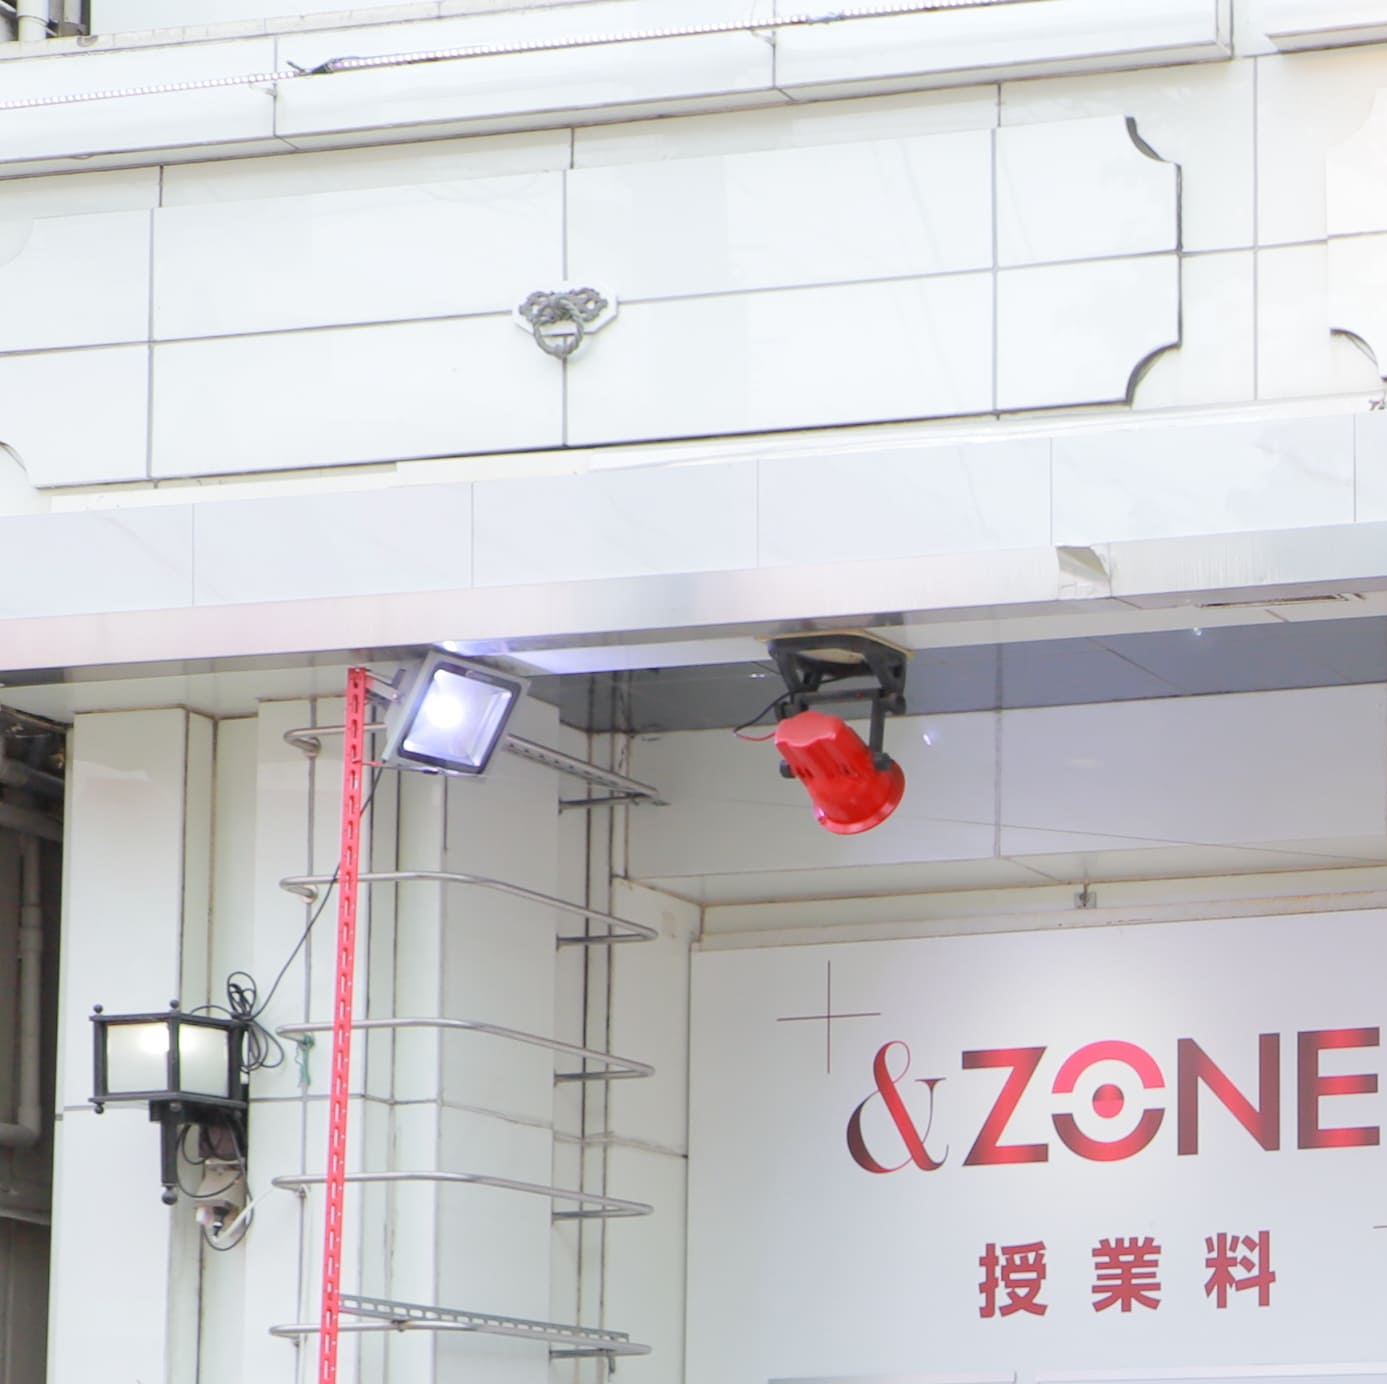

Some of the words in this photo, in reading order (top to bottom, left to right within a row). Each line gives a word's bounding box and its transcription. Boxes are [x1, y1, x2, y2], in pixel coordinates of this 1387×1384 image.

[845, 1026, 1381, 1175] &ZONE
[978, 1230, 1277, 1318] 授業料
